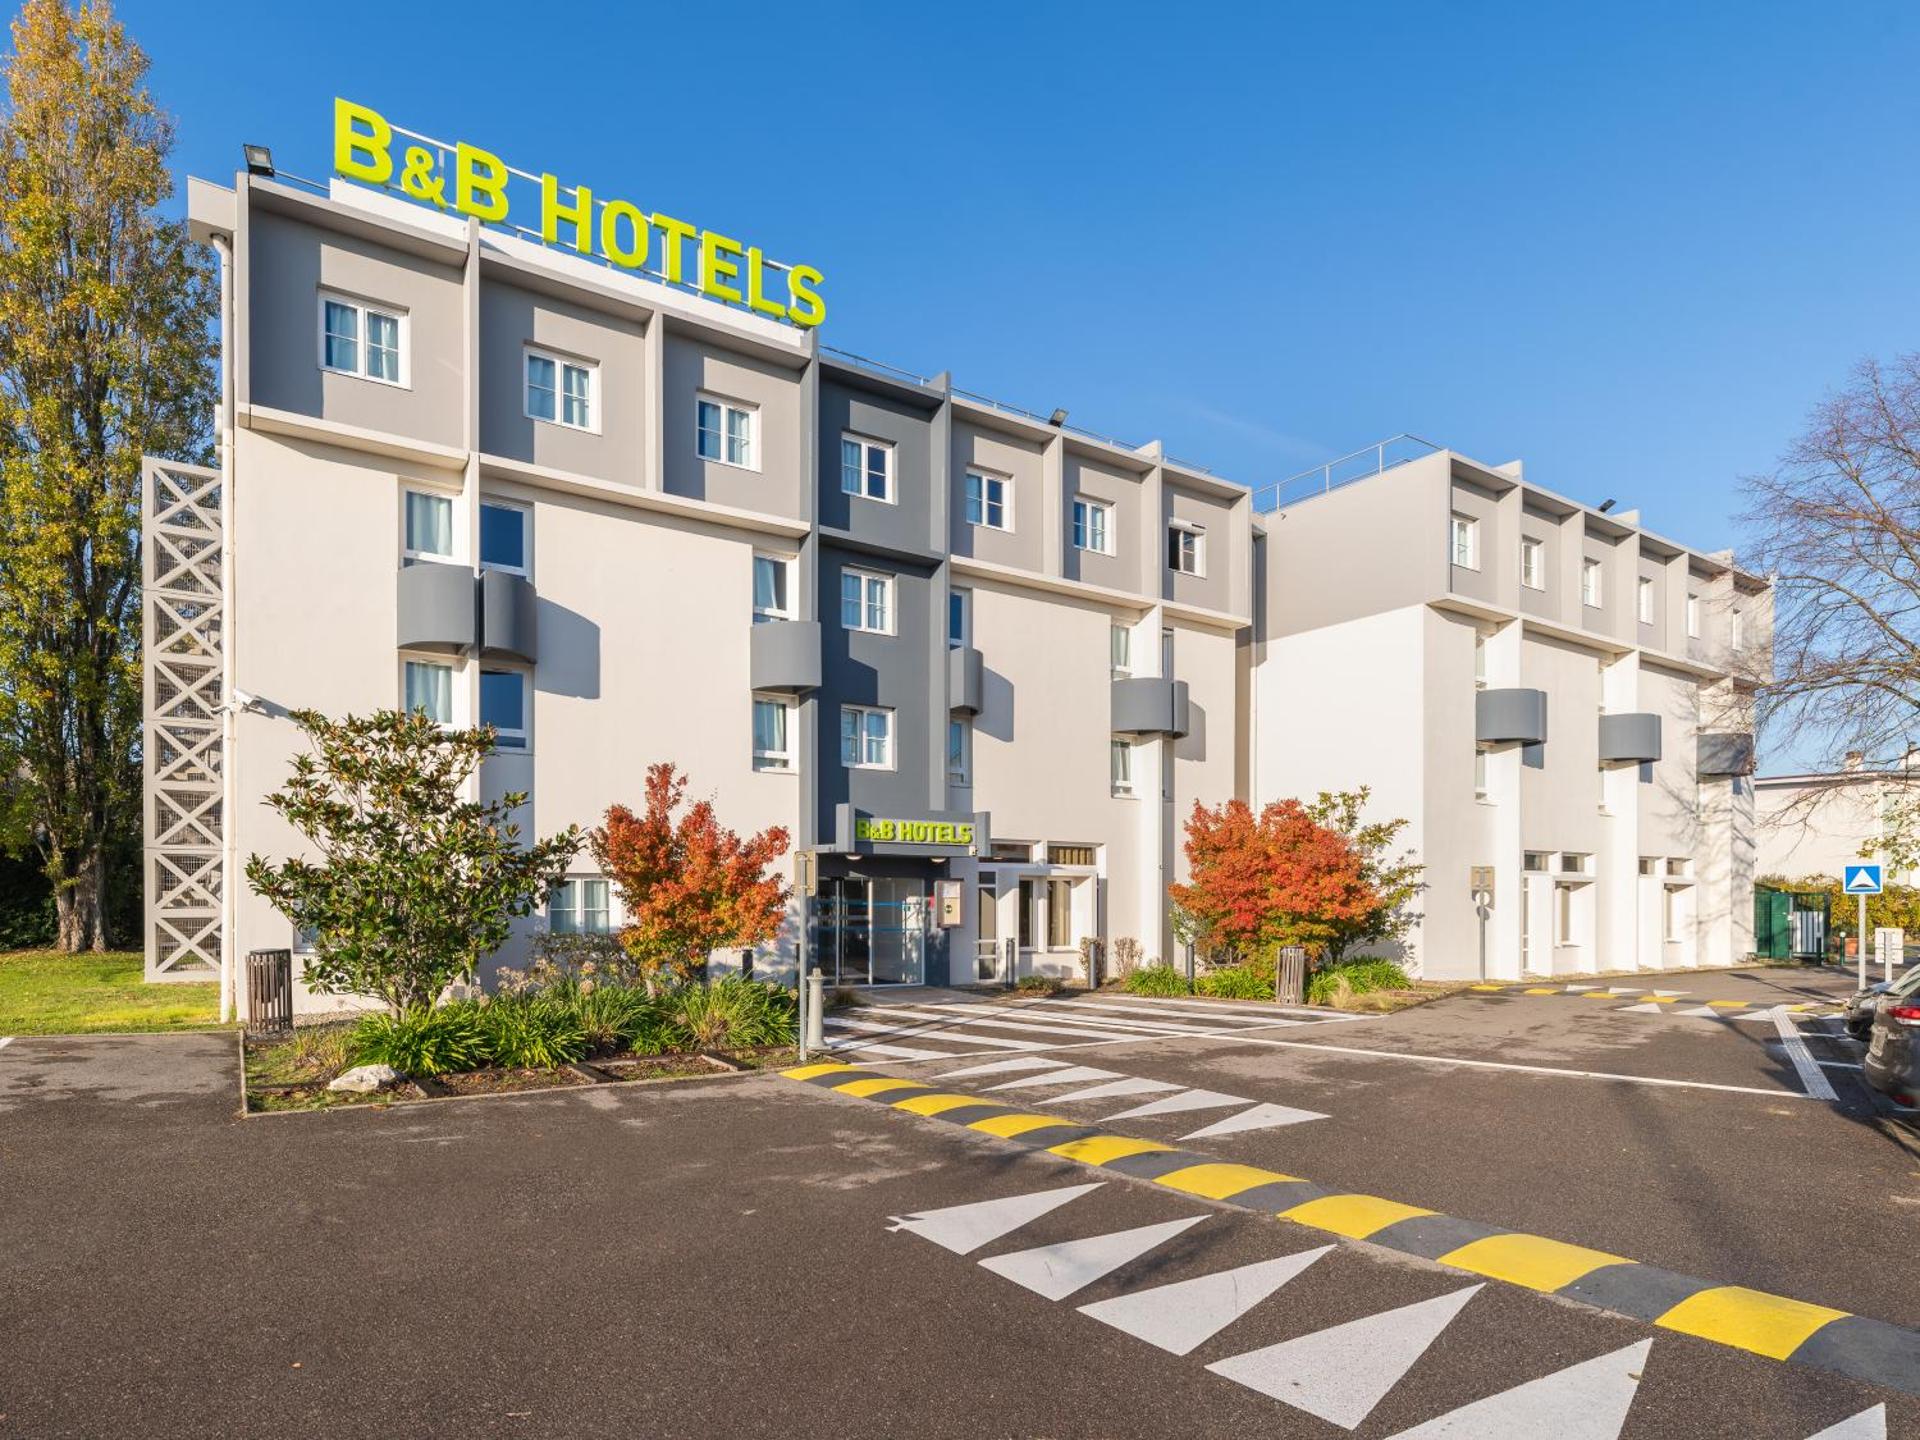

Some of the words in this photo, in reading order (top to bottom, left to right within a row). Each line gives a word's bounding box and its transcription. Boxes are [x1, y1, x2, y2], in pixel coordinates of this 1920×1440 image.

[334, 97, 509, 223] B&B
[541, 172, 826, 328] HOTELS
[857, 819, 896, 841] B&B
[900, 820, 973, 844] HOTELS
